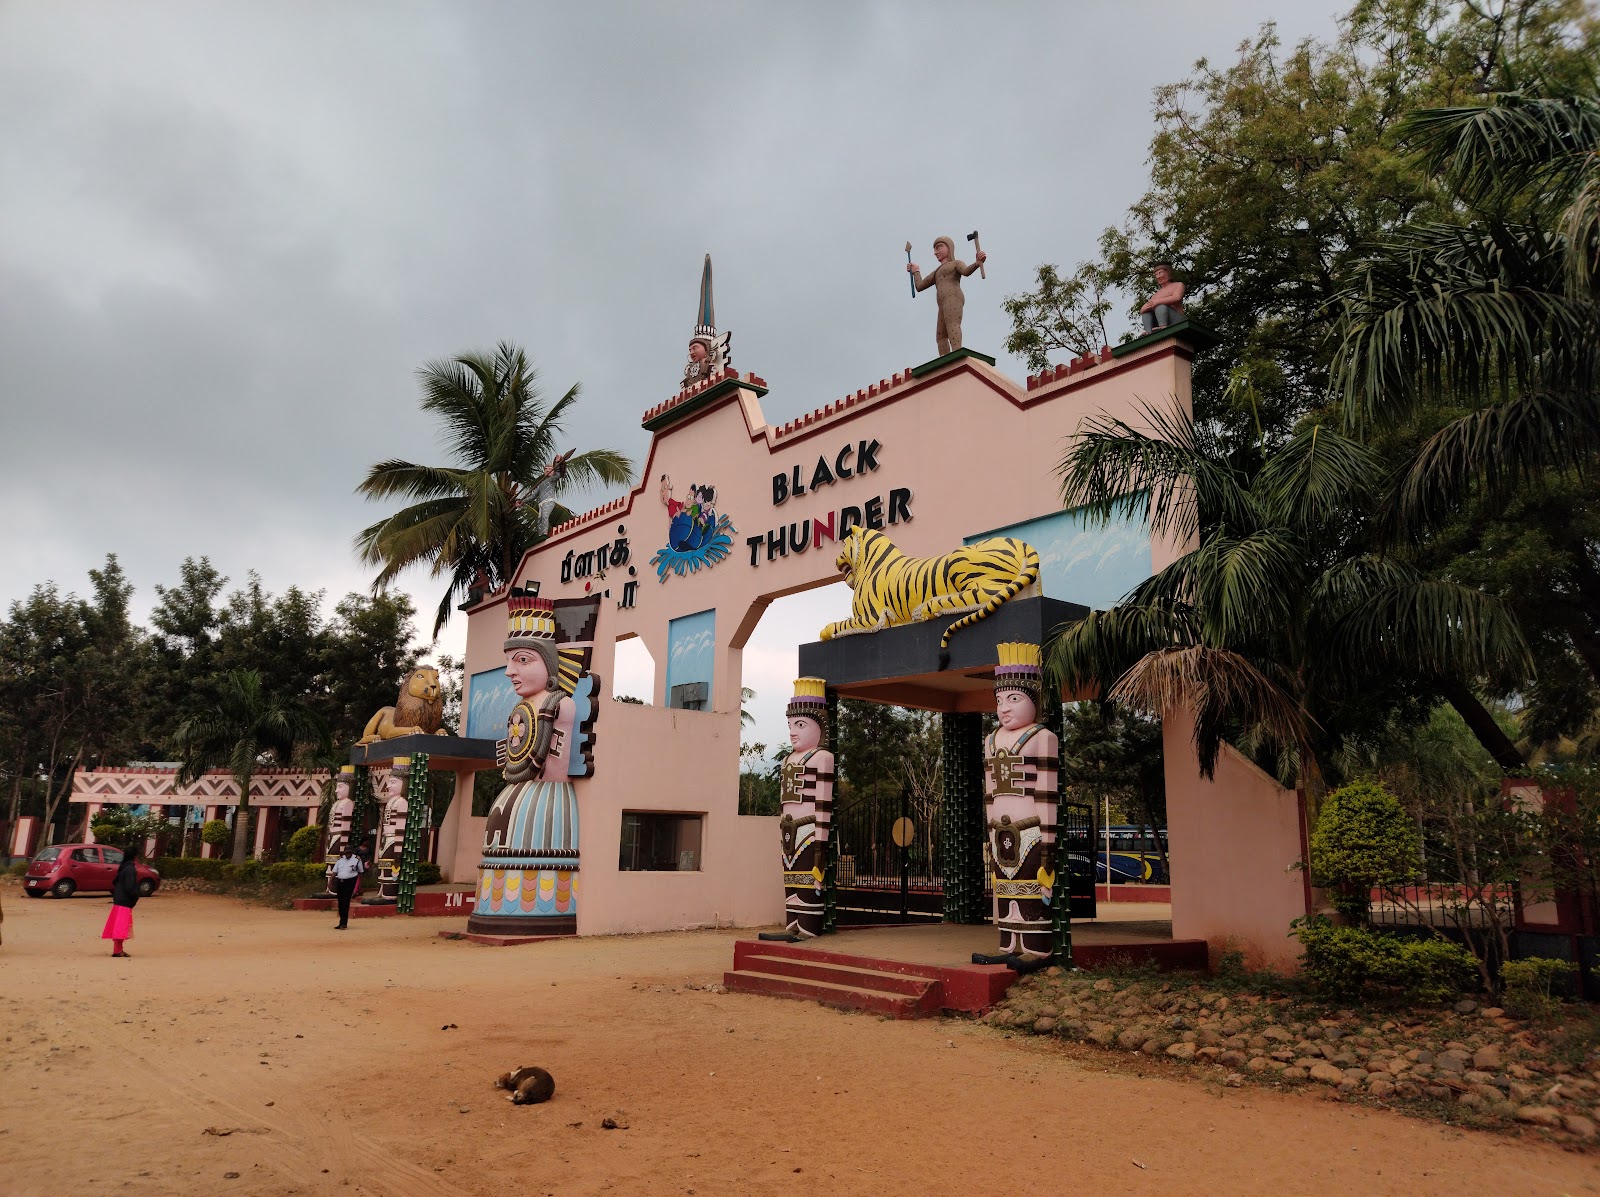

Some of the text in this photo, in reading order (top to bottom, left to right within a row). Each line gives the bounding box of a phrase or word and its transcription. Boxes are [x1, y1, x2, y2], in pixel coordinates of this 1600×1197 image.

[772, 438, 882, 506] BLACK
[560, 524, 632, 584] பிளாக்
[746, 487, 914, 567] THUNDER
[445, 892, 463, 907] IN
